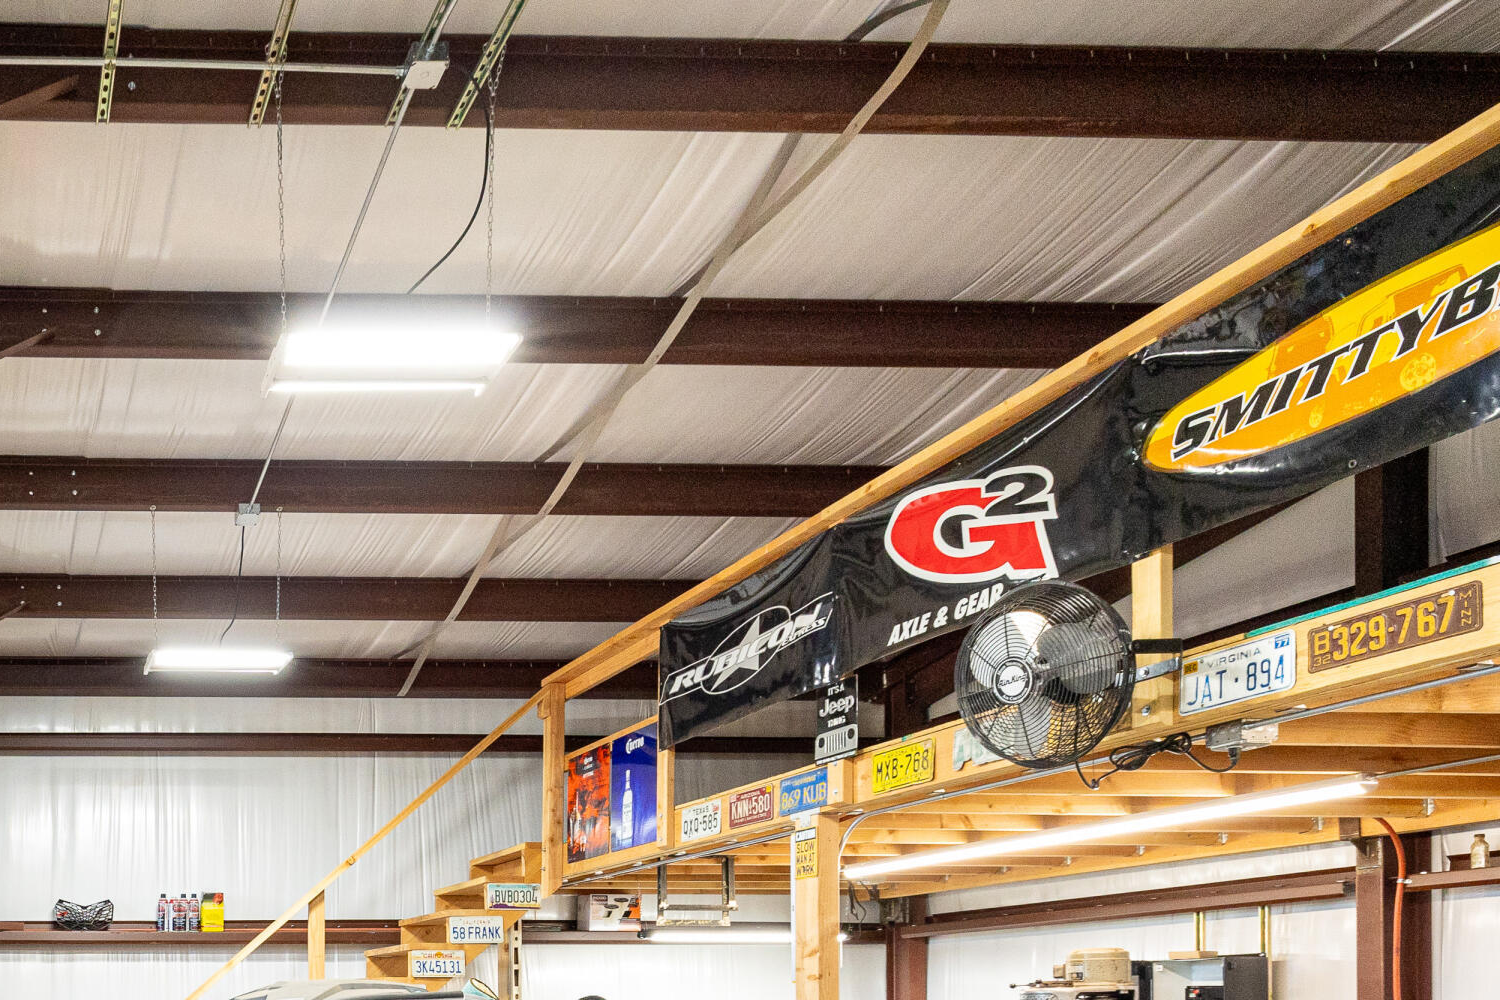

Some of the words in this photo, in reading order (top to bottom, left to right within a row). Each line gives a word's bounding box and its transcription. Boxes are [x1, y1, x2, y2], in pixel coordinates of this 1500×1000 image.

[1171, 260, 1500, 461] SMITTYB
[887, 611, 931, 647] AXLE
[933, 606, 949, 629] &
[953, 582, 1005, 620] GEAR
[668, 602, 824, 695] RUBICON
[1275, 636, 1290, 648] 77
[1207, 647, 1261, 668] VIRGINIA
[1314, 654, 1331, 667] 32
[819, 694, 855, 718] Jeep
[803, 782, 827, 806] KUB
[693, 805, 709, 813] TEXAS
[796, 842, 815, 854] SLOW
[452, 926, 466, 940] 58
[468, 926, 501, 940] FRANK
[415, 960, 462, 974] 3K45131
